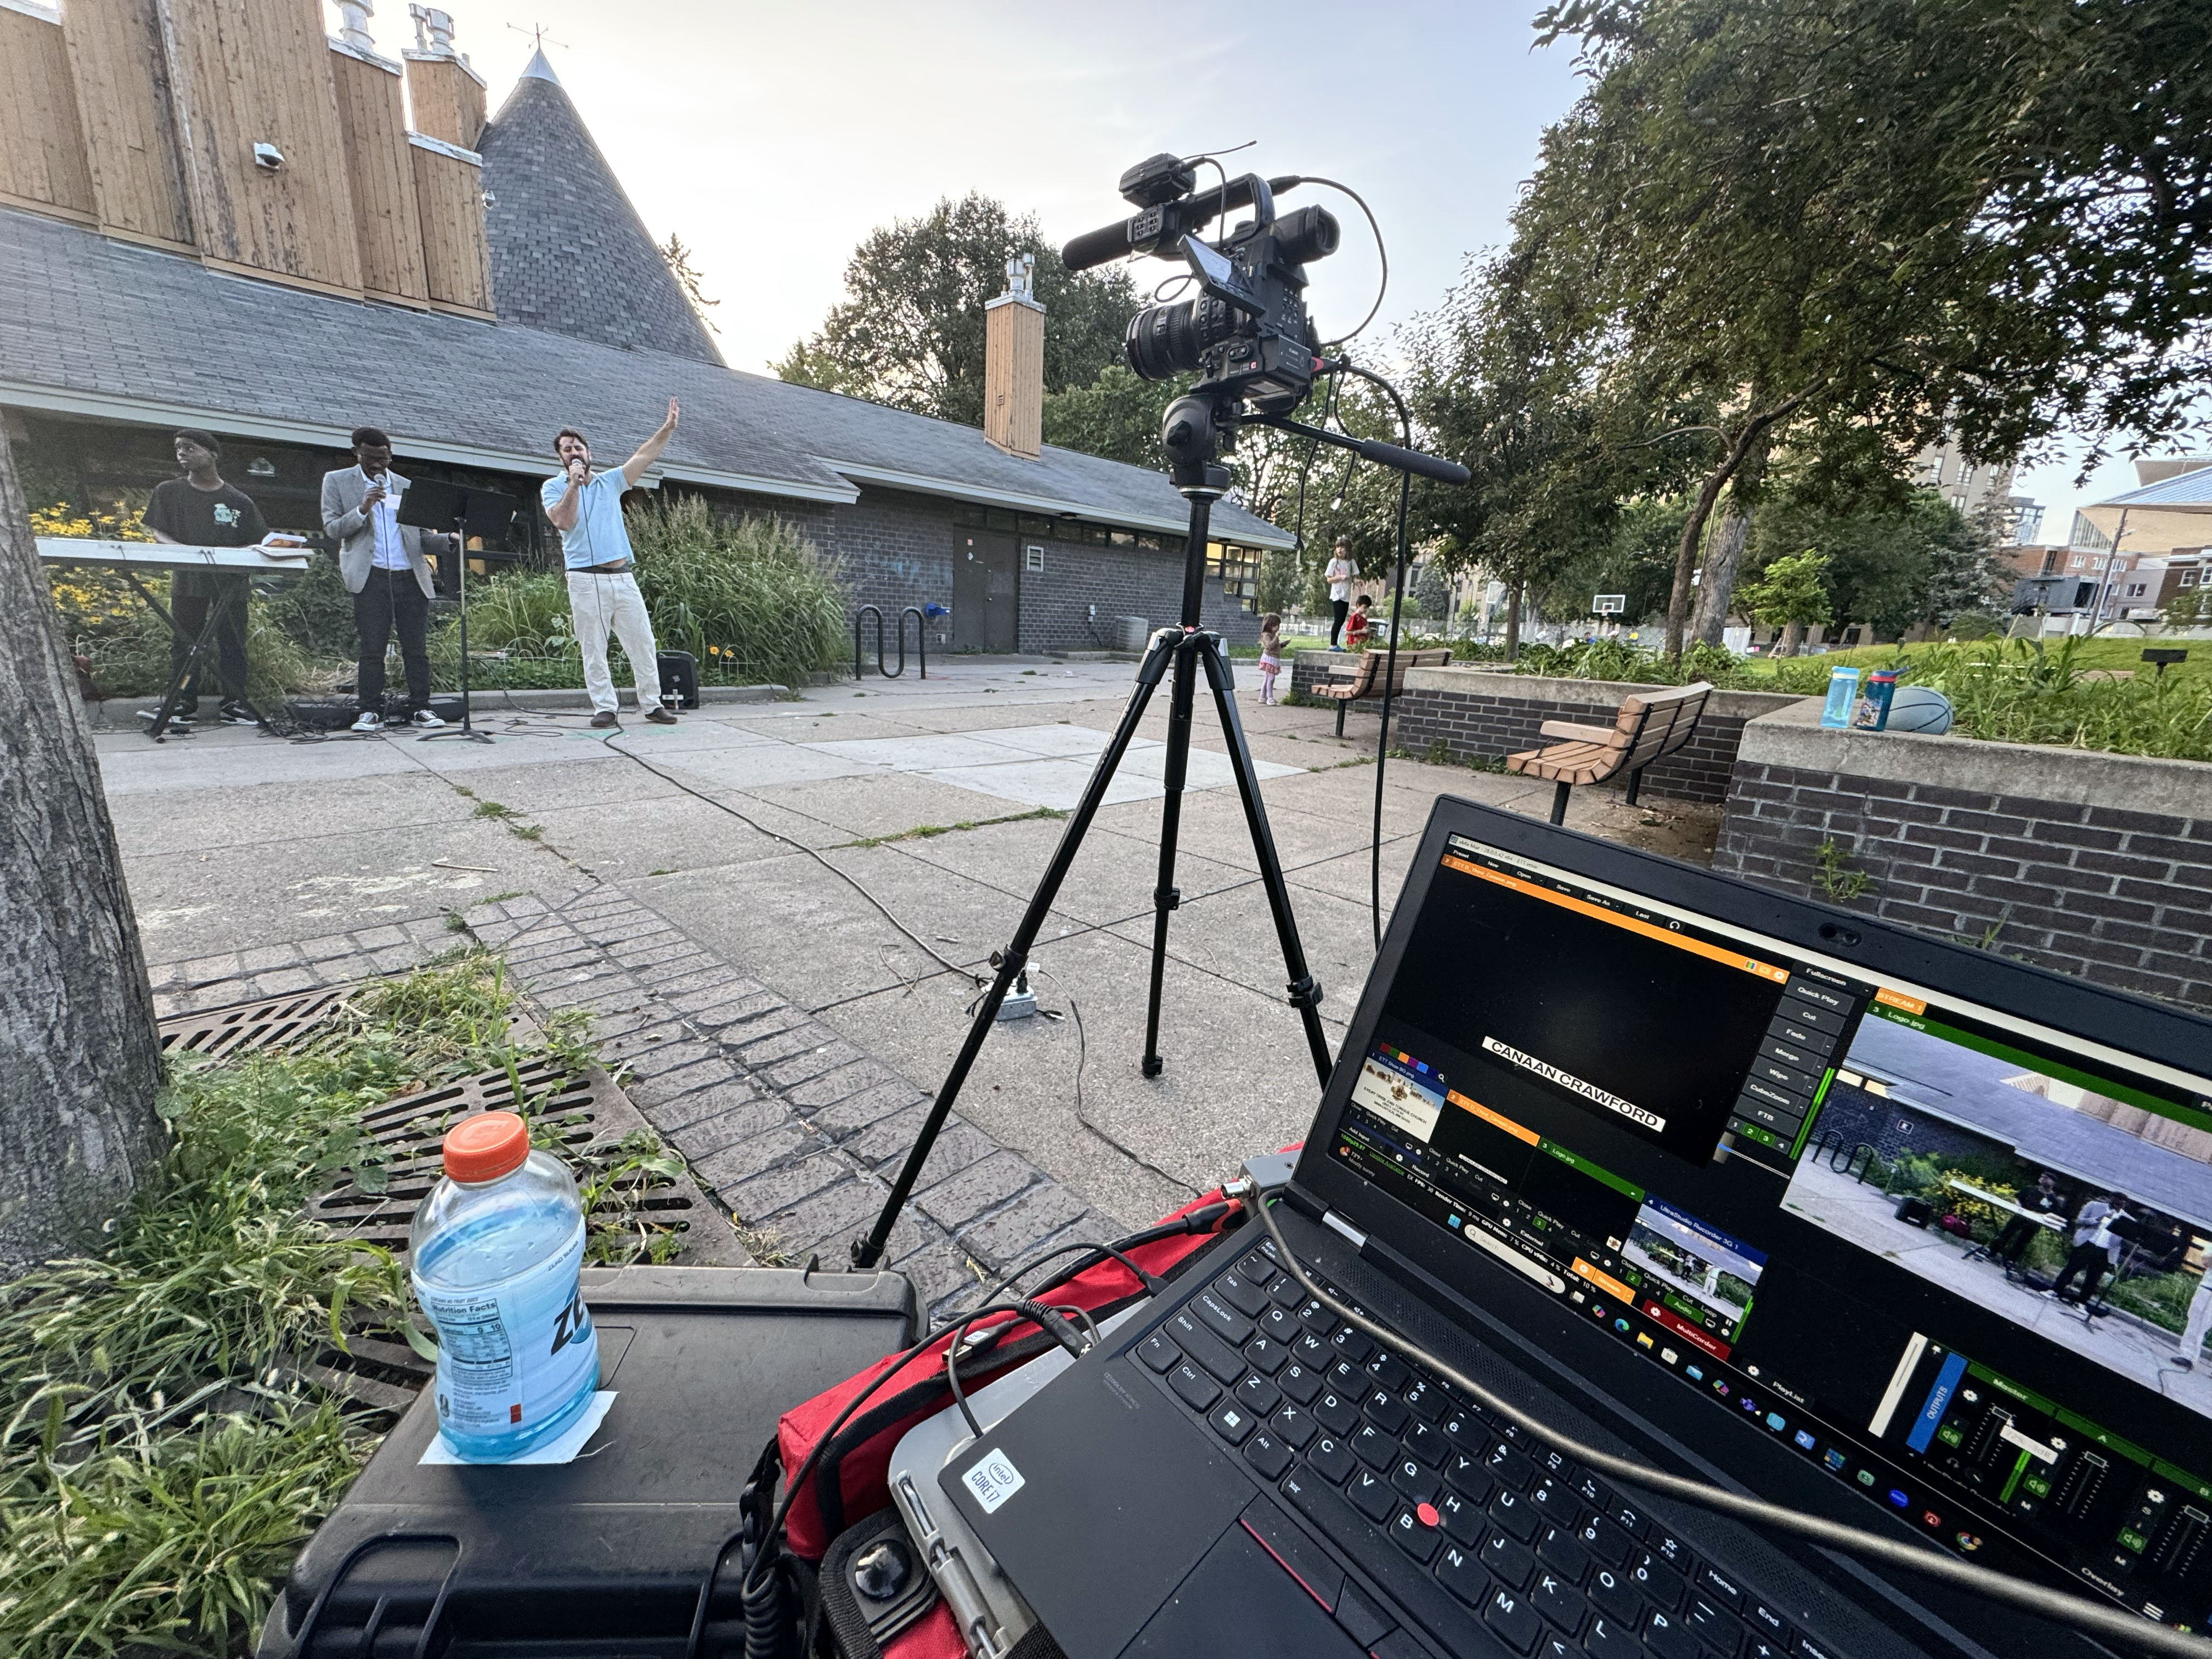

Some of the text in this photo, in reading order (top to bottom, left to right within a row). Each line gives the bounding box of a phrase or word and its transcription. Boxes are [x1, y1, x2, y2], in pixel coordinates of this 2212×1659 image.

[1453, 849, 1470, 859] Preset
[1487, 860, 1499, 869] New
[1516, 870, 1531, 880] Open
[1556, 884, 1571, 893] Save
[1587, 894, 1601, 904] Save
[1636, 911, 1650, 920] Last
[1805, 968, 1847, 986] Fullscreen
[1797, 986, 1840, 1006] Quick Play
[1877, 991, 1915, 1009] STREAM
[1802, 1011, 1816, 1021] Cut
[1887, 1011, 1926, 1030] Logo.jpg
[1786, 1028, 1806, 1041] Fade
[1775, 1047, 1800, 1062] Merge
[1769, 1068, 1789, 1081] Wipe
[1491, 1041, 1658, 1127] CANAAN CRAWFORD
[1750, 1084, 1790, 1105] CubeZoom
[1757, 1110, 1774, 1121] FTB
[1348, 1126, 1358, 1136] Add
[1552, 1148, 1575, 1164] Logo.jpg
[1412, 1164, 1430, 1178] Record
[1429, 1147, 1483, 1182] Close Quick Play Cut
[1518, 1199, 1581, 1239] Close Quick Play Cut
[1660, 1204, 1692, 1226] UltraStudio
[1693, 1222, 1722, 1241] Recorder
[1722, 1238, 1733, 1248] 3G
[1435, 1190, 1453, 1206] Render
[1472, 1214, 1480, 1222] ms
[1481, 1219, 1493, 1229] GPU
[1521, 1244, 1534, 1254] CPU
[1563, 1268, 1580, 1283] Total:
[1583, 1281, 1590, 1289] 10
[1591, 1285, 1596, 1293] %
[1480, 1235, 1499, 1251] Search
[1520, 1229, 1544, 1247] External
[1265, 1242, 1277, 1251] Esc
[1226, 1276, 1238, 1288] Tab
[1598, 1276, 1621, 1293] Stream
[1621, 1259, 1718, 1318] Close Quick Play Cut Loop
[432, 1302, 496, 1314] Nutrition Facts
[1203, 1295, 1232, 1323] CapsLock
[1674, 1300, 1692, 1316] Audio
[1178, 1316, 1194, 1331] Shift
[1272, 1311, 1283, 1322] Q
[1150, 1337, 1160, 1348] Fn
[1305, 1335, 1319, 1349] W
[1676, 1323, 1717, 1351] MultiCorder
[1256, 1339, 1267, 1350] A
[1182, 1366, 1196, 1380] Ctrl
[1290, 1366, 1301, 1378] S
[1338, 1362, 1350, 1375] E
[1372, 1363, 1380, 1372] 4
[1248, 1376, 1261, 1389] Z
[1993, 1378, 2029, 1400] Master
[1374, 1392, 1387, 1406] R
[1409, 1391, 1419, 1401] 5
[1773, 1380, 1805, 1404] PlayList
[1325, 1395, 1337, 1408] D
[1926, 1385, 1949, 1420] OUTPUTS
[1283, 1406, 1297, 1420] X
[1363, 1427, 1376, 1437] F
[1417, 1423, 1427, 1435] T
[1449, 1422, 1459, 1432] 6
[1257, 1437, 1270, 1449] Alt
[1321, 1440, 1334, 1453] C
[1459, 1456, 1470, 1469] Y
[1492, 1454, 1503, 1464] 7
[993, 1463, 1011, 1483] intel
[1404, 1462, 1418, 1477] G
[972, 1470, 1001, 1503] CORE i7
[1363, 1473, 1374, 1487] V
[1501, 1492, 1514, 1506] U
[1536, 1489, 1547, 1502] 8
[1582, 1486, 1595, 1499] F10
[1446, 1496, 1460, 1513] H
[1400, 1514, 1413, 1529] B
[1548, 1530, 1556, 1541] I
[1585, 1527, 1596, 1540] 9
[1493, 1538, 1505, 1549] J
[1447, 1549, 1463, 1567] N
[1661, 1546, 1675, 1559] F12
[1542, 1576, 1558, 1595] K
[1600, 1571, 1615, 1589] O
[1708, 1570, 1738, 1595] Home
[1497, 1592, 1514, 1613] M
[1654, 1613, 1668, 1628] P
[1758, 1606, 1780, 1628] End
[1595, 1620, 1606, 1639] L
